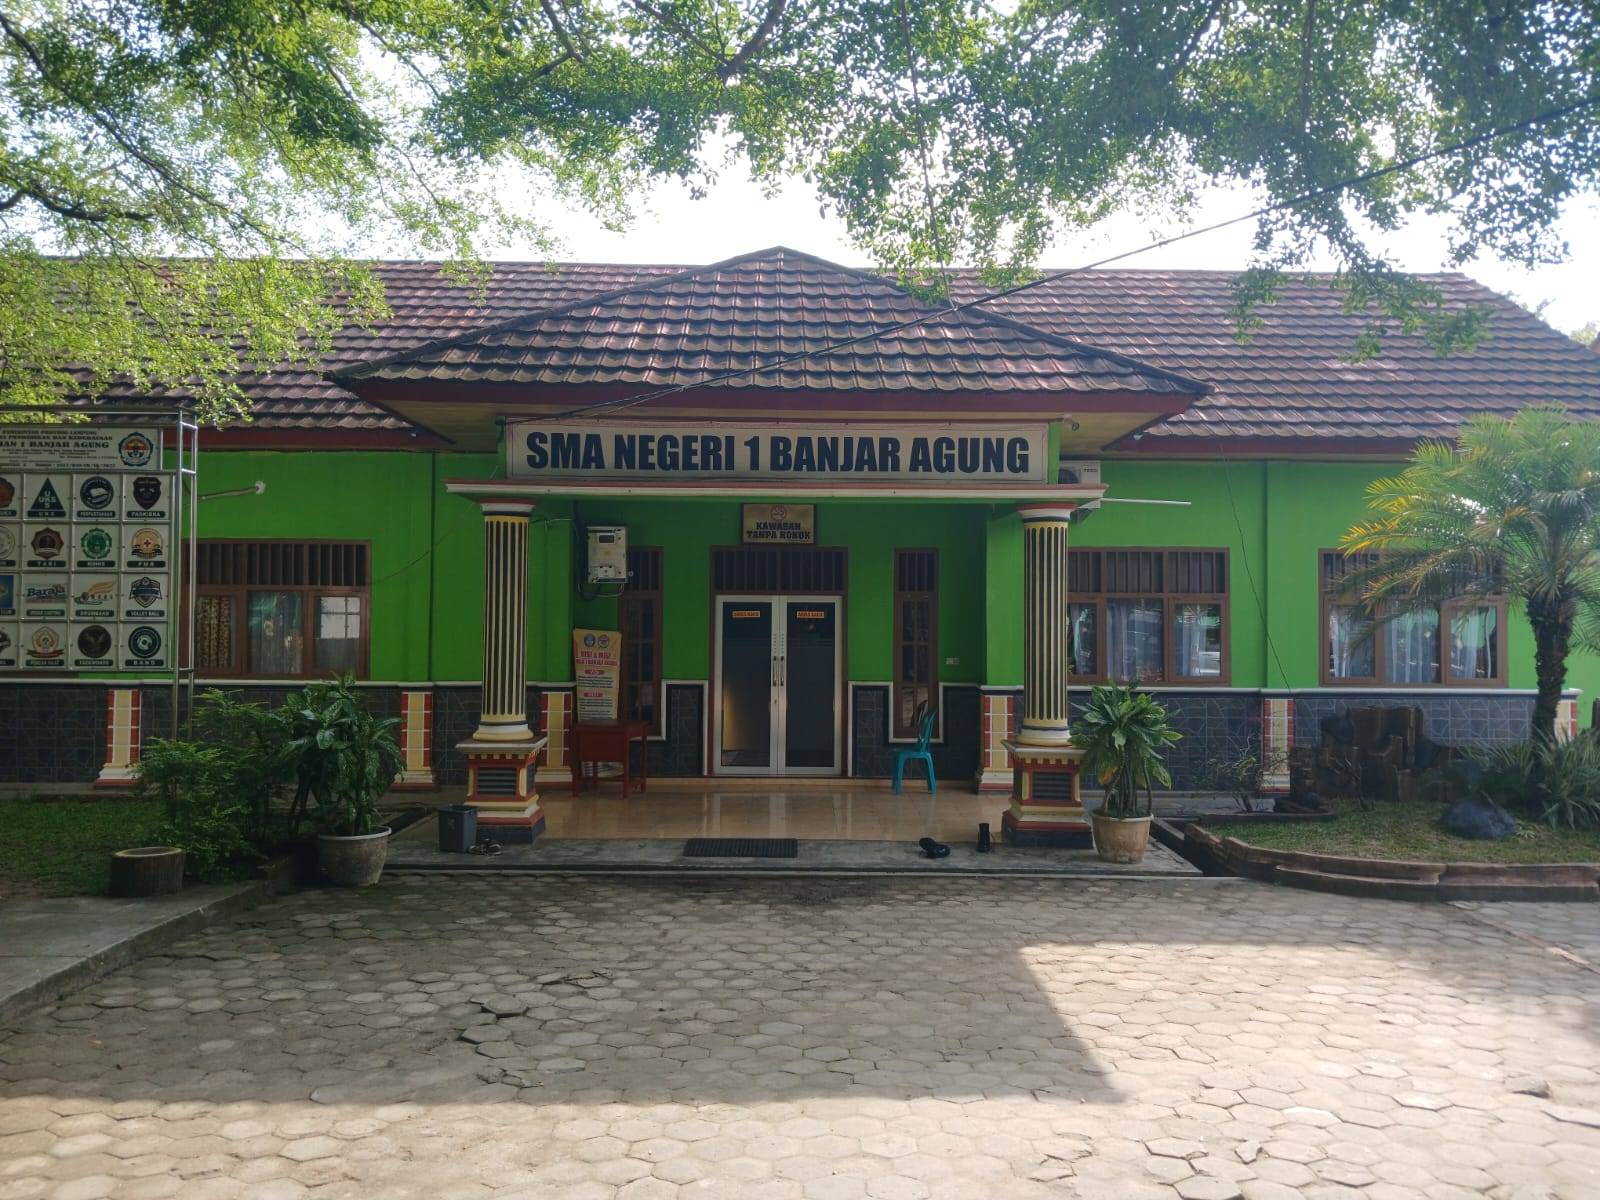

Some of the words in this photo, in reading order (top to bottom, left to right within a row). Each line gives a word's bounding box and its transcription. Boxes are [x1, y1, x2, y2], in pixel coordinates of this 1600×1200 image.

[73, 441, 110, 449] AGUNG
[526, 431, 602, 470] SMA
[614, 433, 735, 472] NEGERI
[744, 435, 760, 471] 1
[769, 435, 901, 473] BANJAR
[908, 436, 1030, 475] AGUNG
[756, 521, 801, 531] KAWASAN
[746, 530, 777, 539] TANPA
